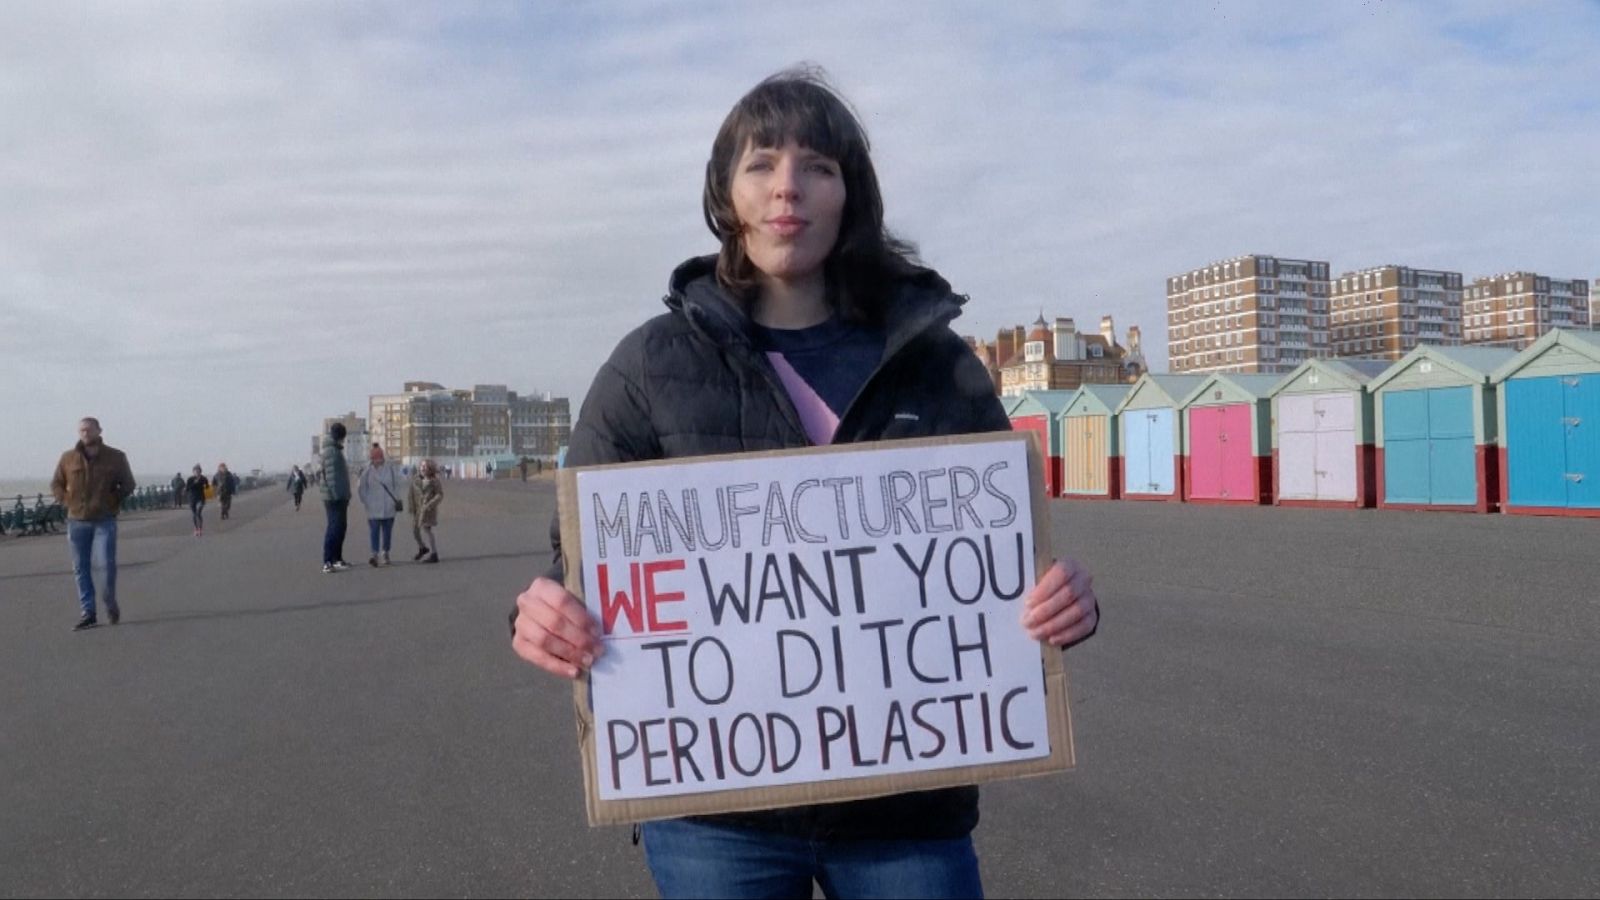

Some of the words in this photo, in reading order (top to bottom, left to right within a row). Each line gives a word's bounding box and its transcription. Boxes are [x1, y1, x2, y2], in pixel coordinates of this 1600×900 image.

[593, 461, 1017, 557] MANUFACTURERS
[597, 559, 688, 635] WE
[699, 545, 877, 626] WANT
[893, 532, 1026, 608] YOU
[641, 635, 734, 708] TO
[776, 612, 993, 698] DITCH
[607, 712, 801, 790] PERIOD
[817, 686, 1035, 770] PLASTIC
